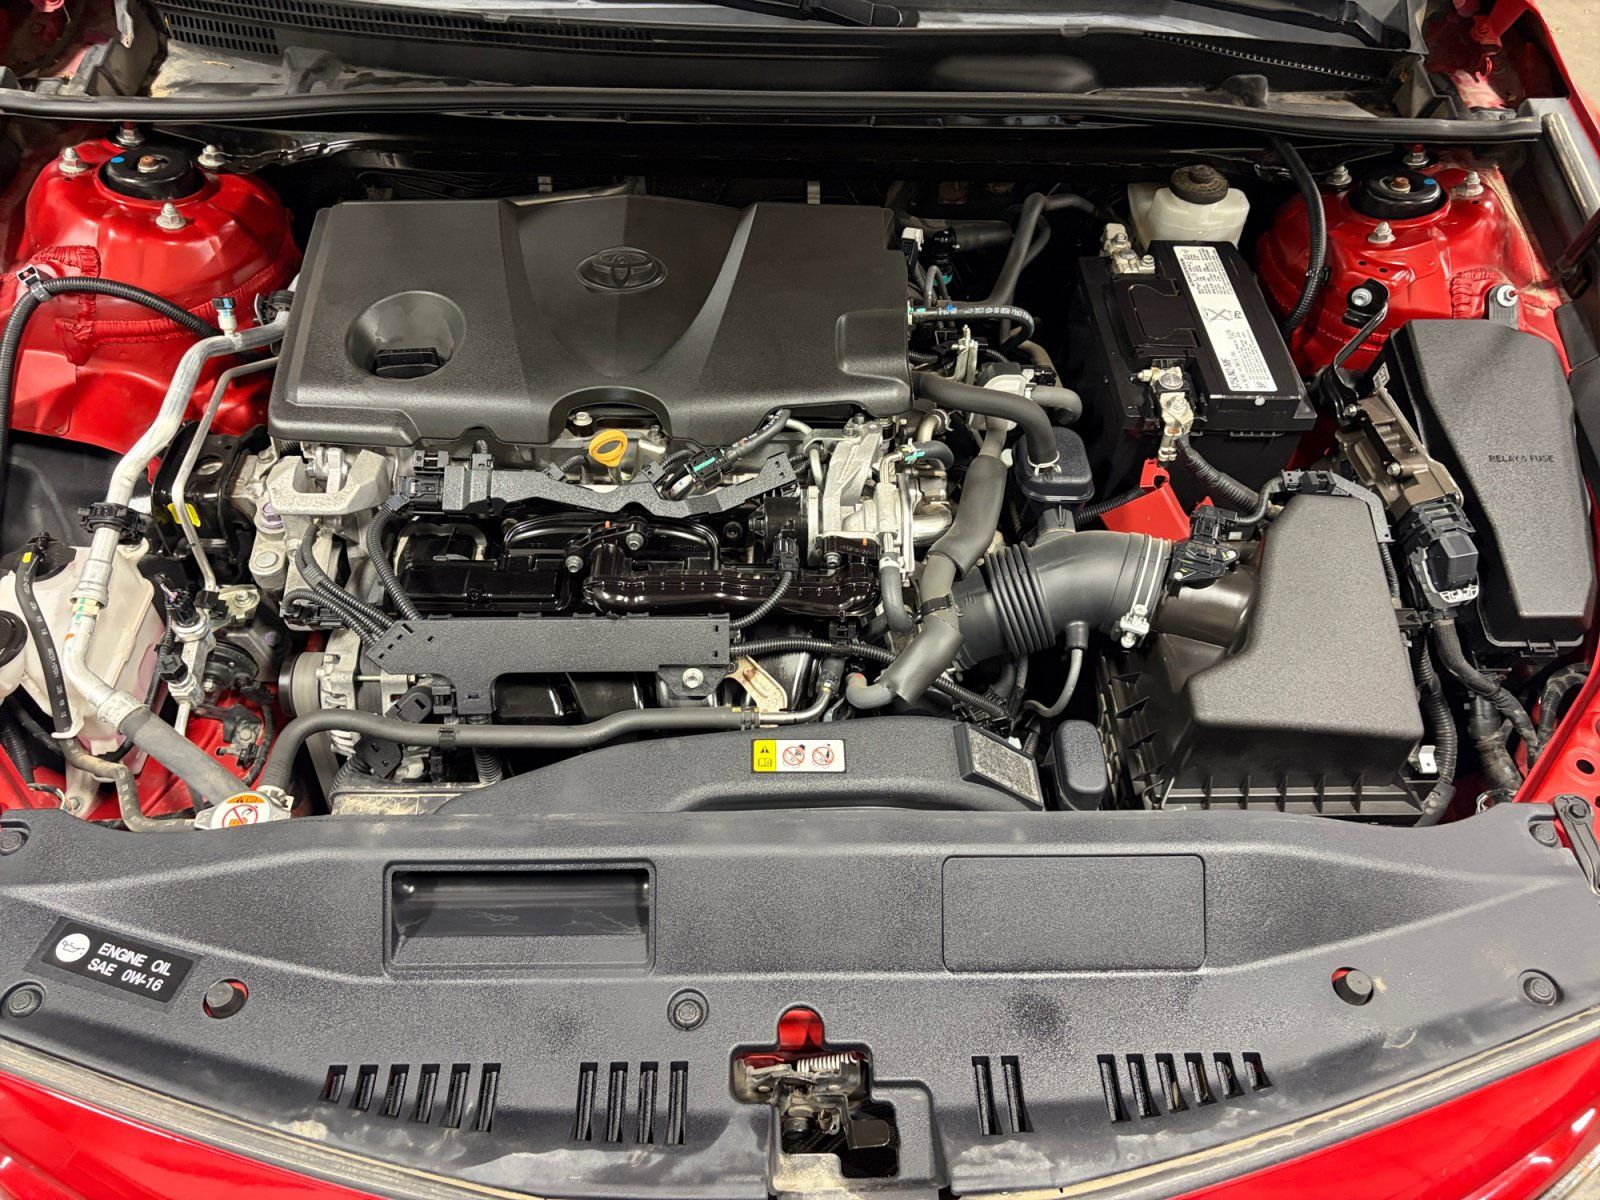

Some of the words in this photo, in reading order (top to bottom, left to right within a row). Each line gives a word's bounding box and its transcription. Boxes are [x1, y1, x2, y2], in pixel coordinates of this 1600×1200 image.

[1488, 454, 1519, 463] RELAY
[1529, 454, 1555, 463] FUSE
[87, 957, 118, 977] SAE
[120, 969, 164, 992] 0W-16
[97, 942, 148, 968] ENGINE
[150, 959, 172, 977] OIL
